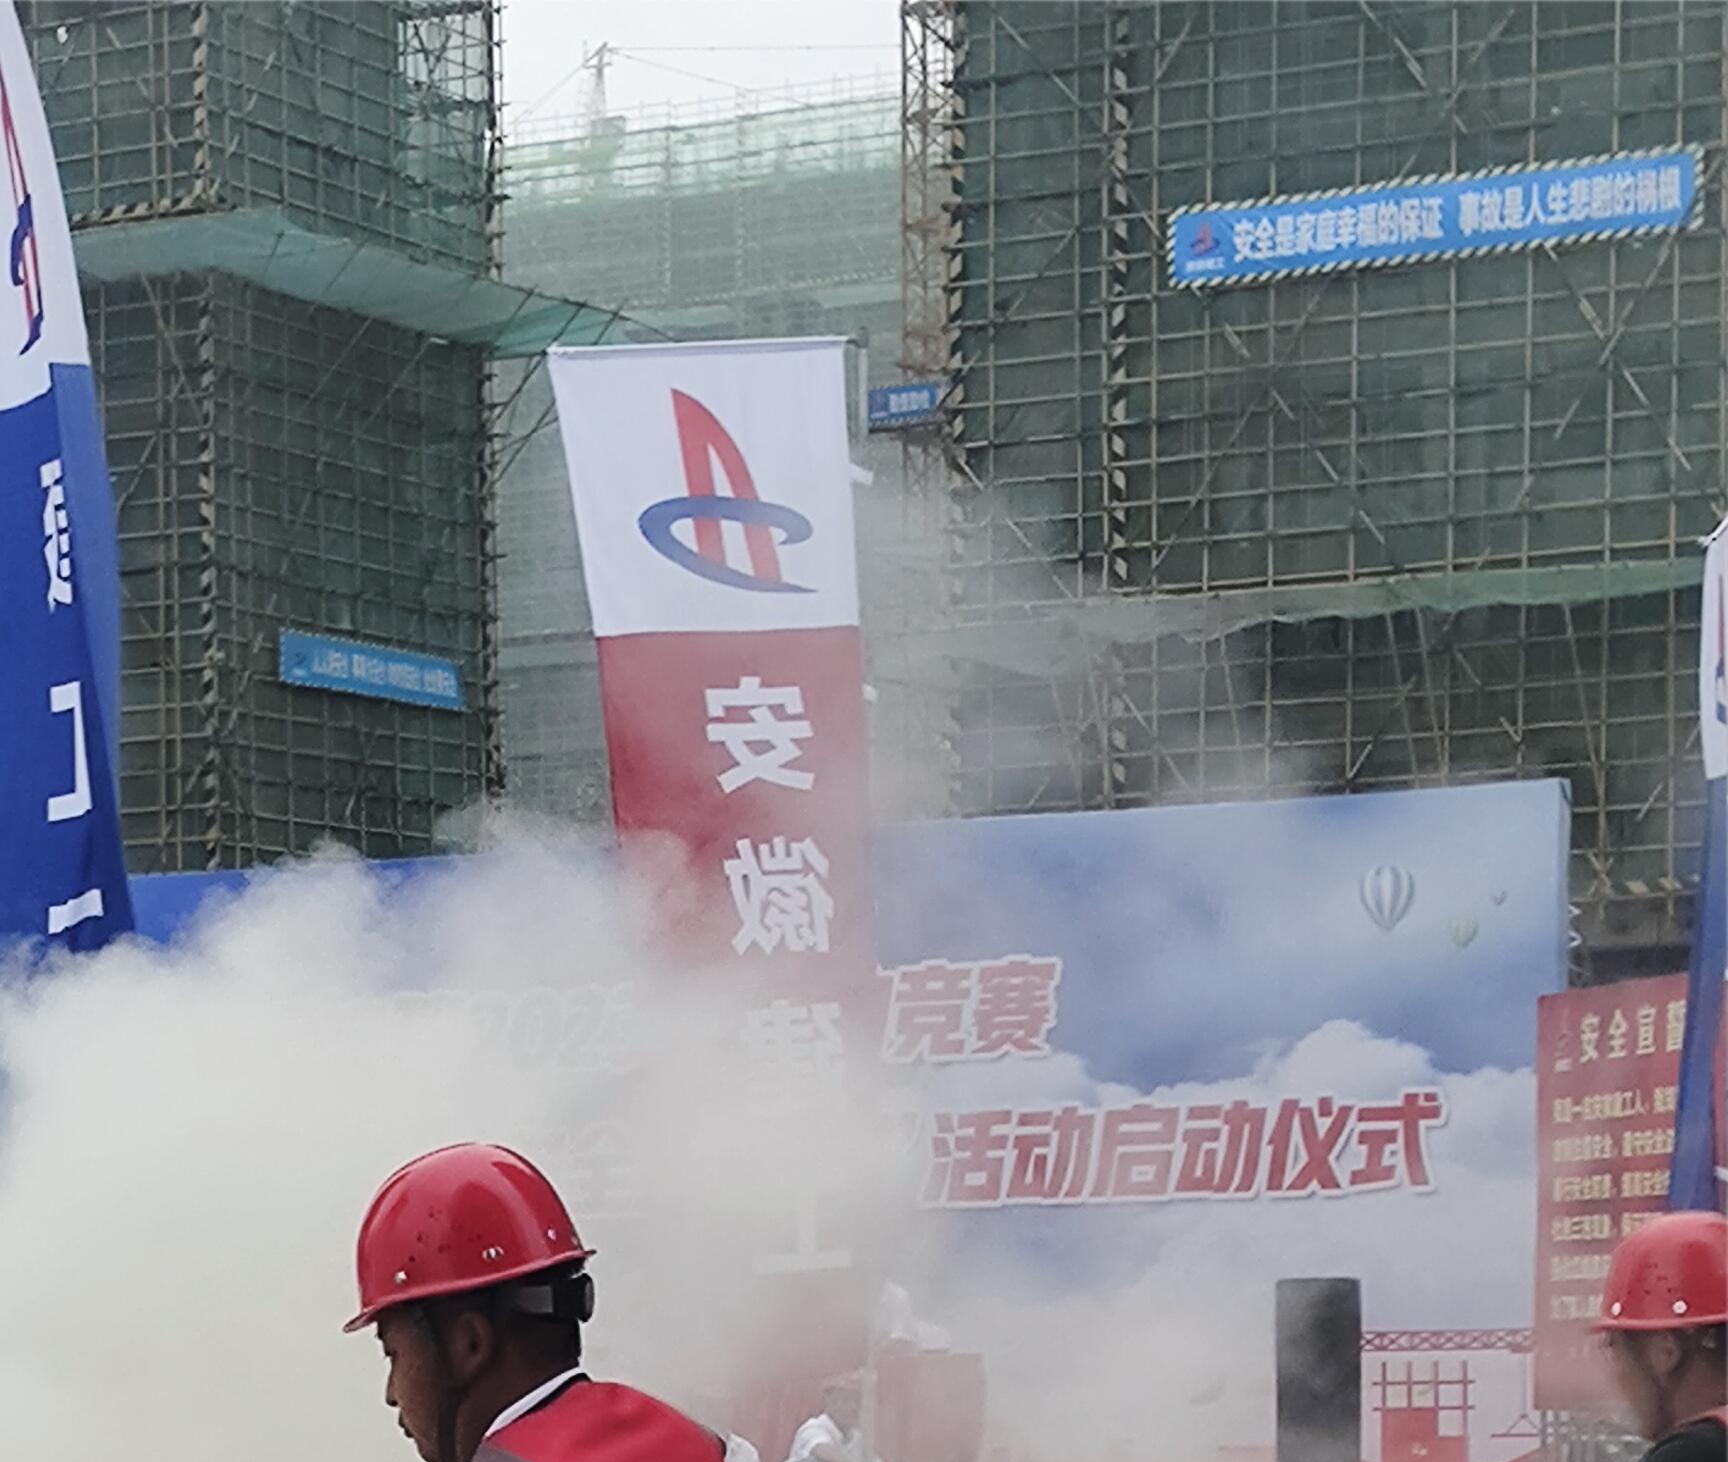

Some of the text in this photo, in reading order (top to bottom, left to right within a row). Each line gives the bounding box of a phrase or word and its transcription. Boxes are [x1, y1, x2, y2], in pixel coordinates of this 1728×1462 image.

[924, 1089, 1444, 1206] 活动启动仪式
